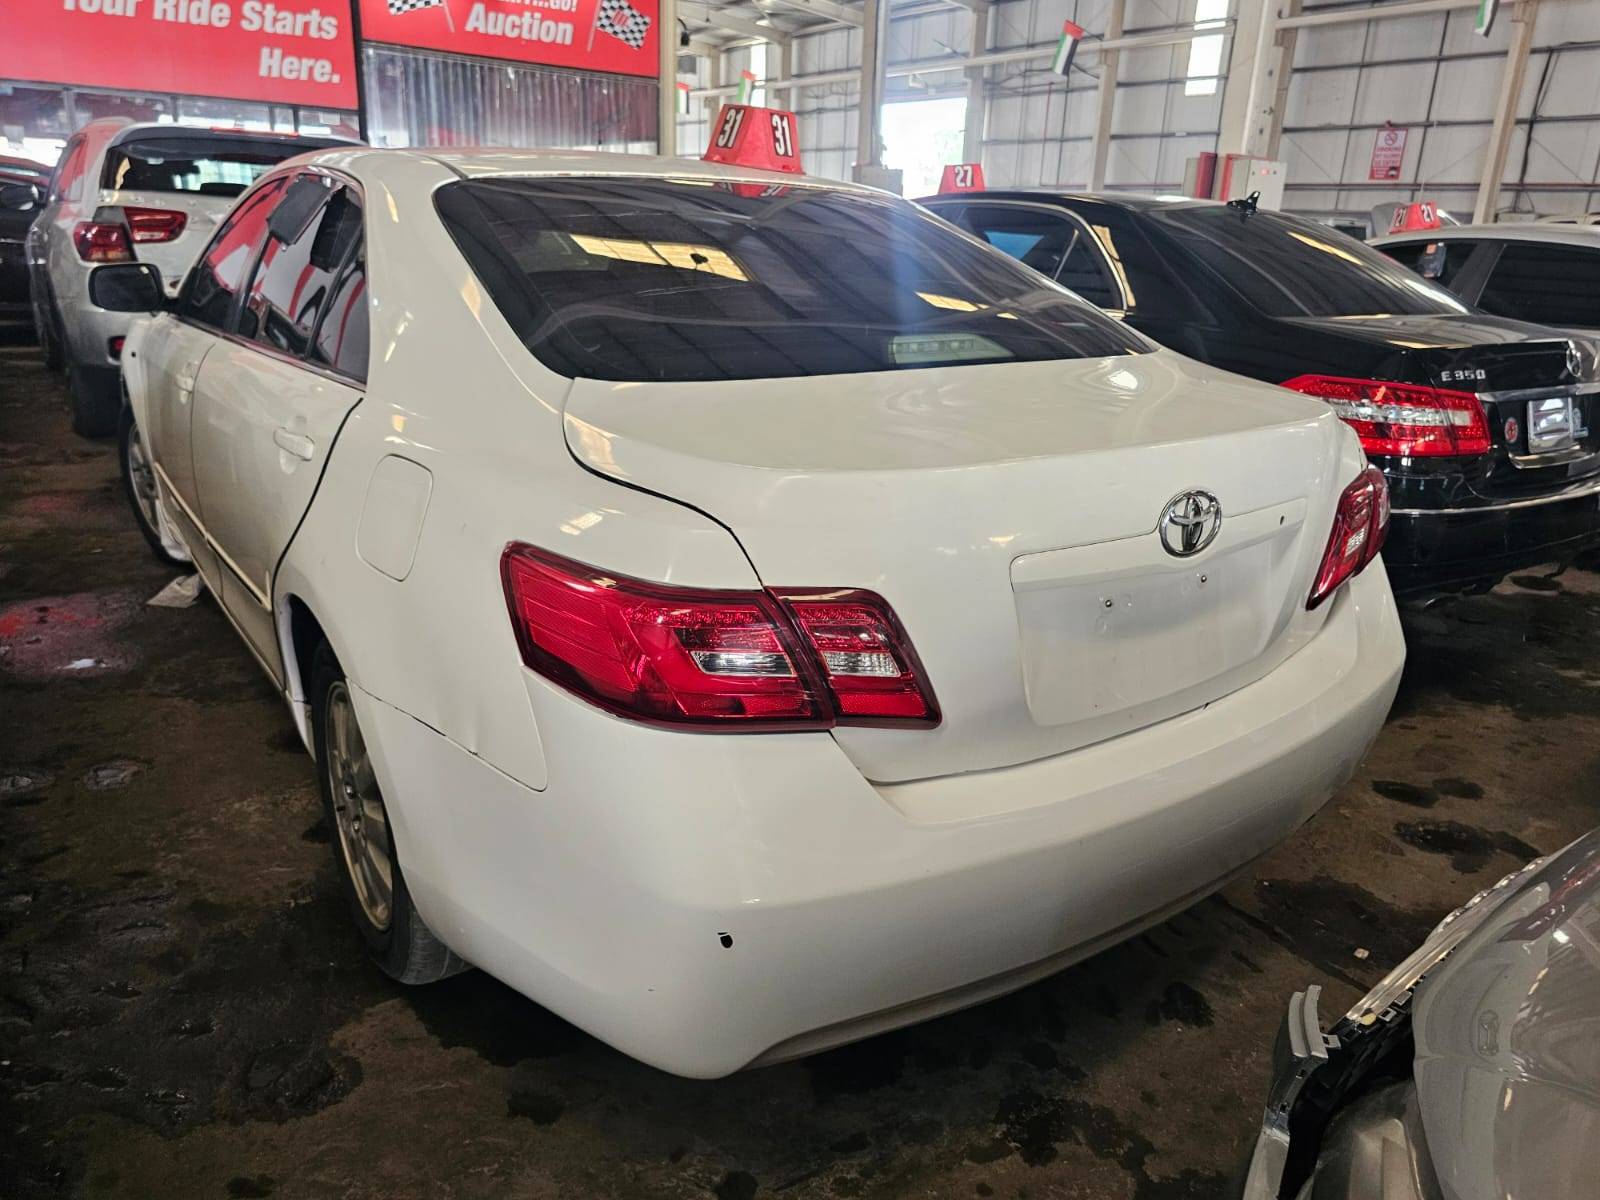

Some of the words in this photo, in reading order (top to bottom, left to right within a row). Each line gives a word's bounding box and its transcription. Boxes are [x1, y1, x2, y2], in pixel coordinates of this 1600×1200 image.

[152, 0, 231, 28] Ride
[240, 1, 338, 40] Starts
[464, 3, 574, 45] Auction
[258, 47, 341, 84] Here.
[717, 108, 745, 148] 31
[771, 113, 793, 157] 31
[954, 165, 973, 188] 27
[1441, 370, 1452, 382] E
[1454, 369, 1486, 381] 350
